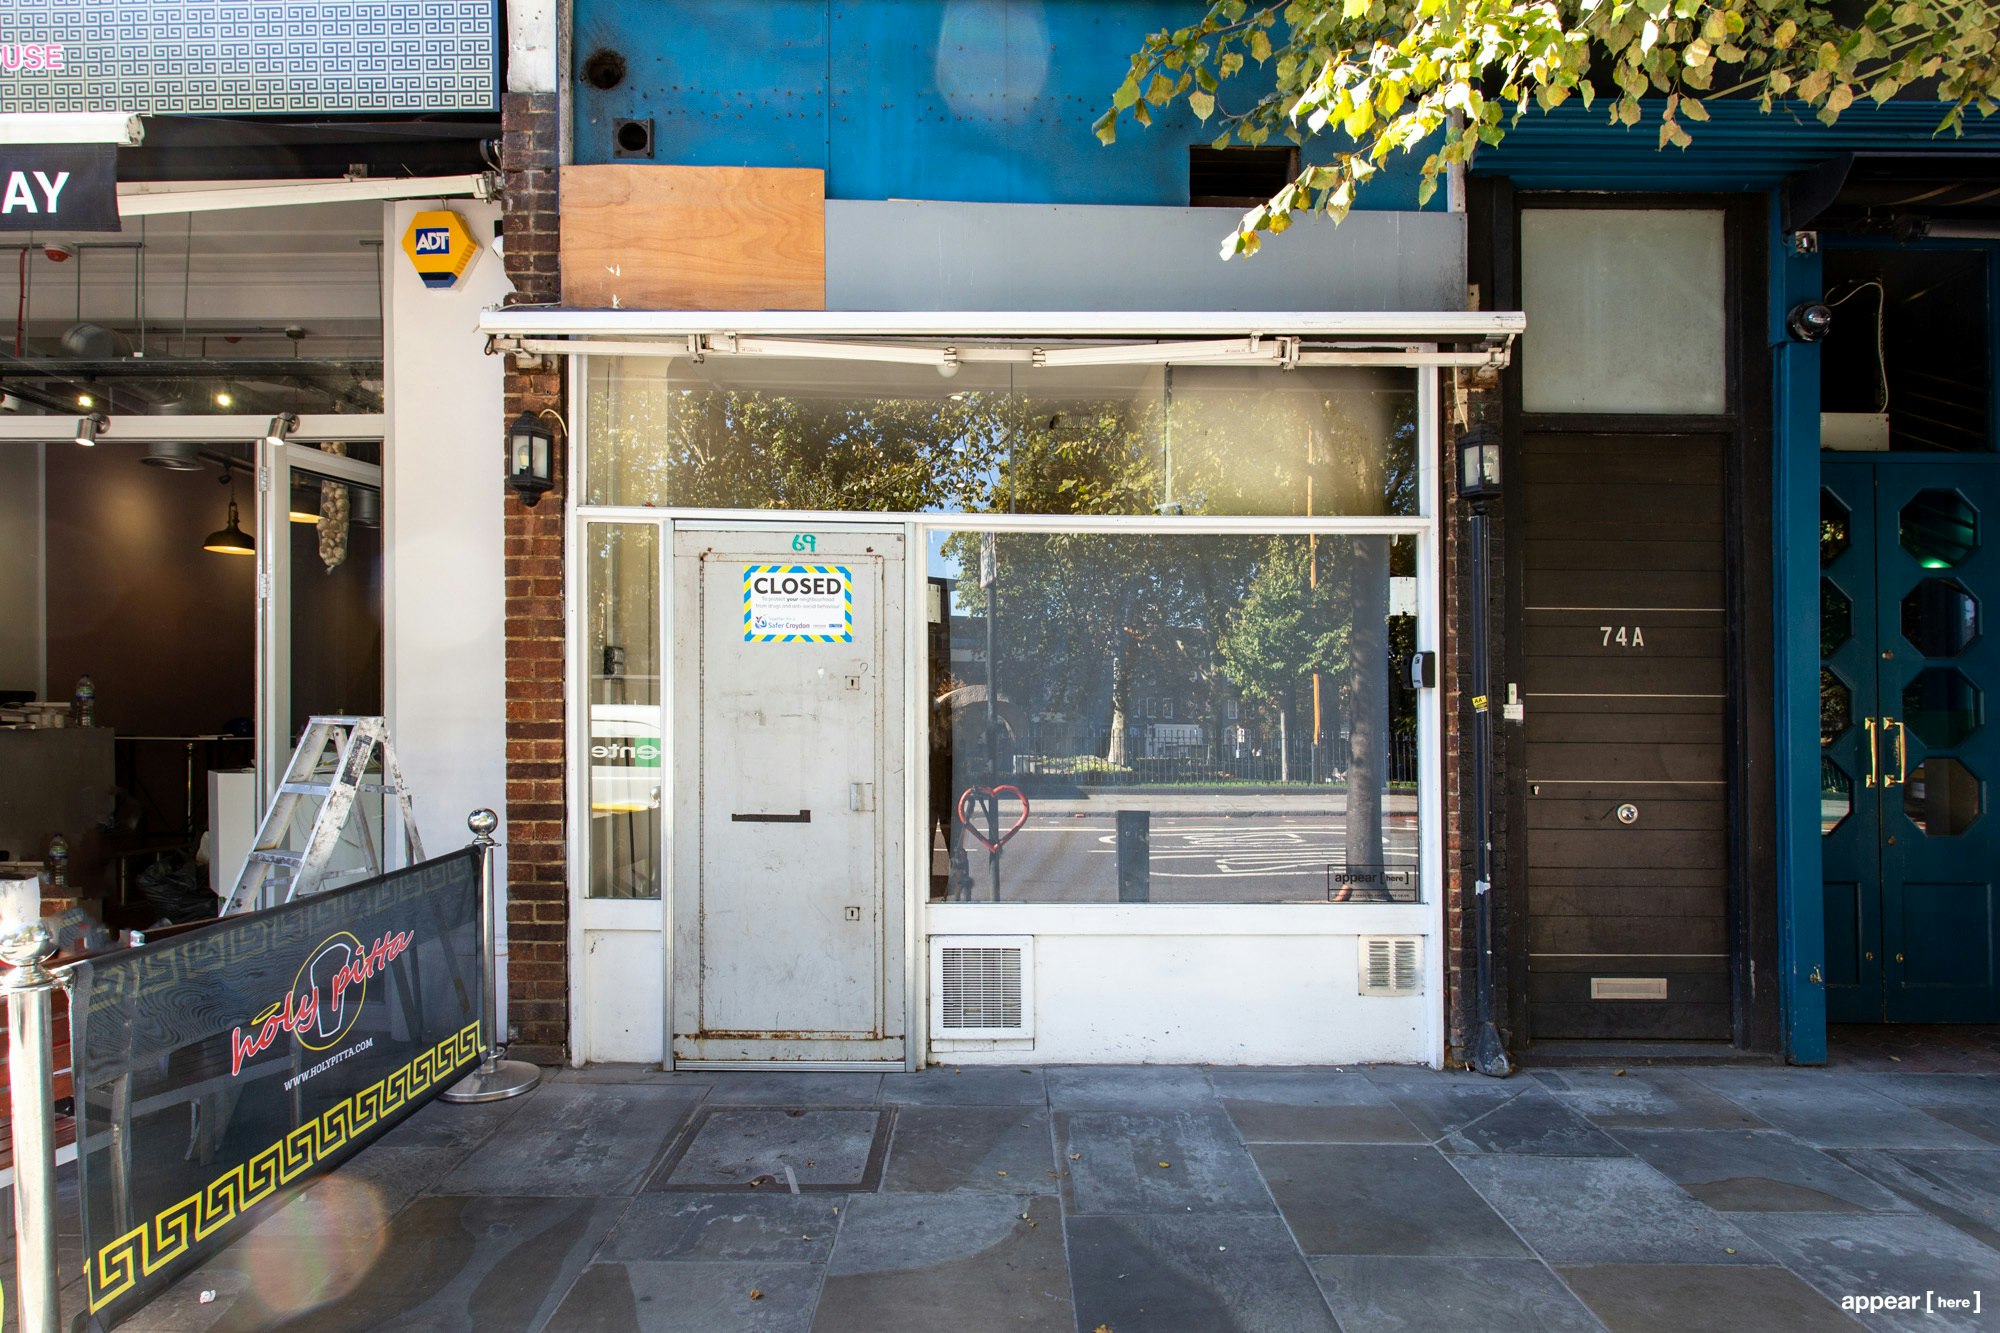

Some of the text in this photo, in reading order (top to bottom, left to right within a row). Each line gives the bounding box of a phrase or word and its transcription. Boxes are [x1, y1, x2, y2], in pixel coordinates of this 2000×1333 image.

[0, 45, 64, 70] USE
[2, 171, 70, 213] AY
[416, 232, 449, 250] ADT
[792, 534, 816, 552] 69
[754, 577, 841, 594] CLOSED
[1335, 873, 1377, 884] appear
[232, 930, 415, 1076] holy pitta
[283, 1037, 374, 1091] WWW.HOLYPITTA.COM
